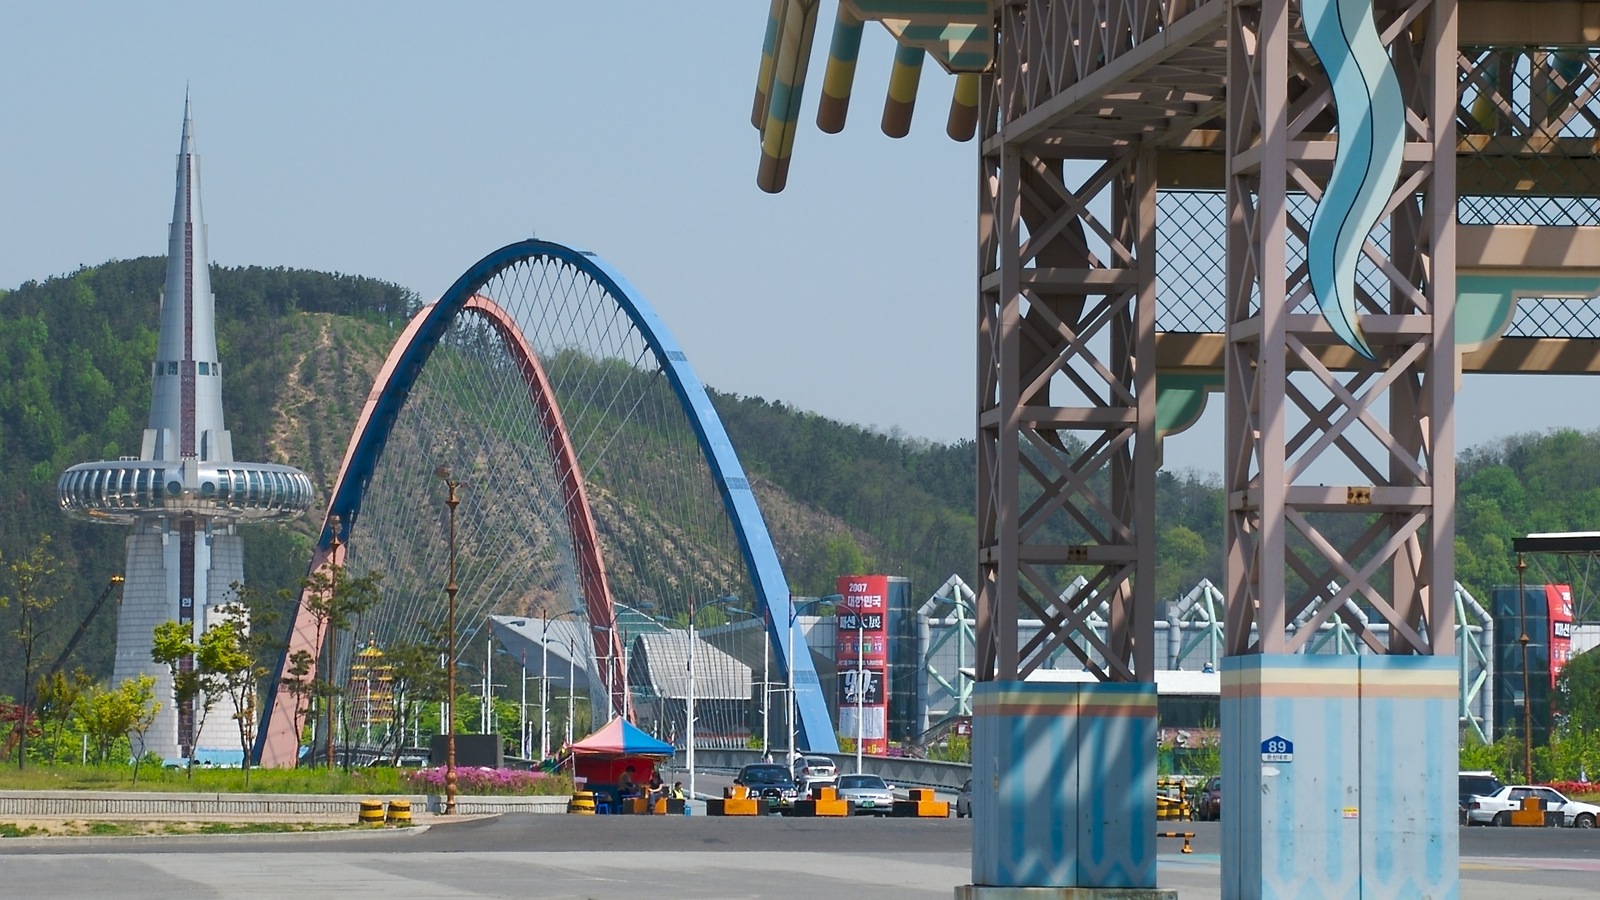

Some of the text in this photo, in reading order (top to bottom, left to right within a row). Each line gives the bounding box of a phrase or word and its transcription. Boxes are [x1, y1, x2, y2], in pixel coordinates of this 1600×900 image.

[849, 583, 867, 592] 2007
[847, 595, 881, 607] 대한민국
[1268, 741, 1286, 753] 89
